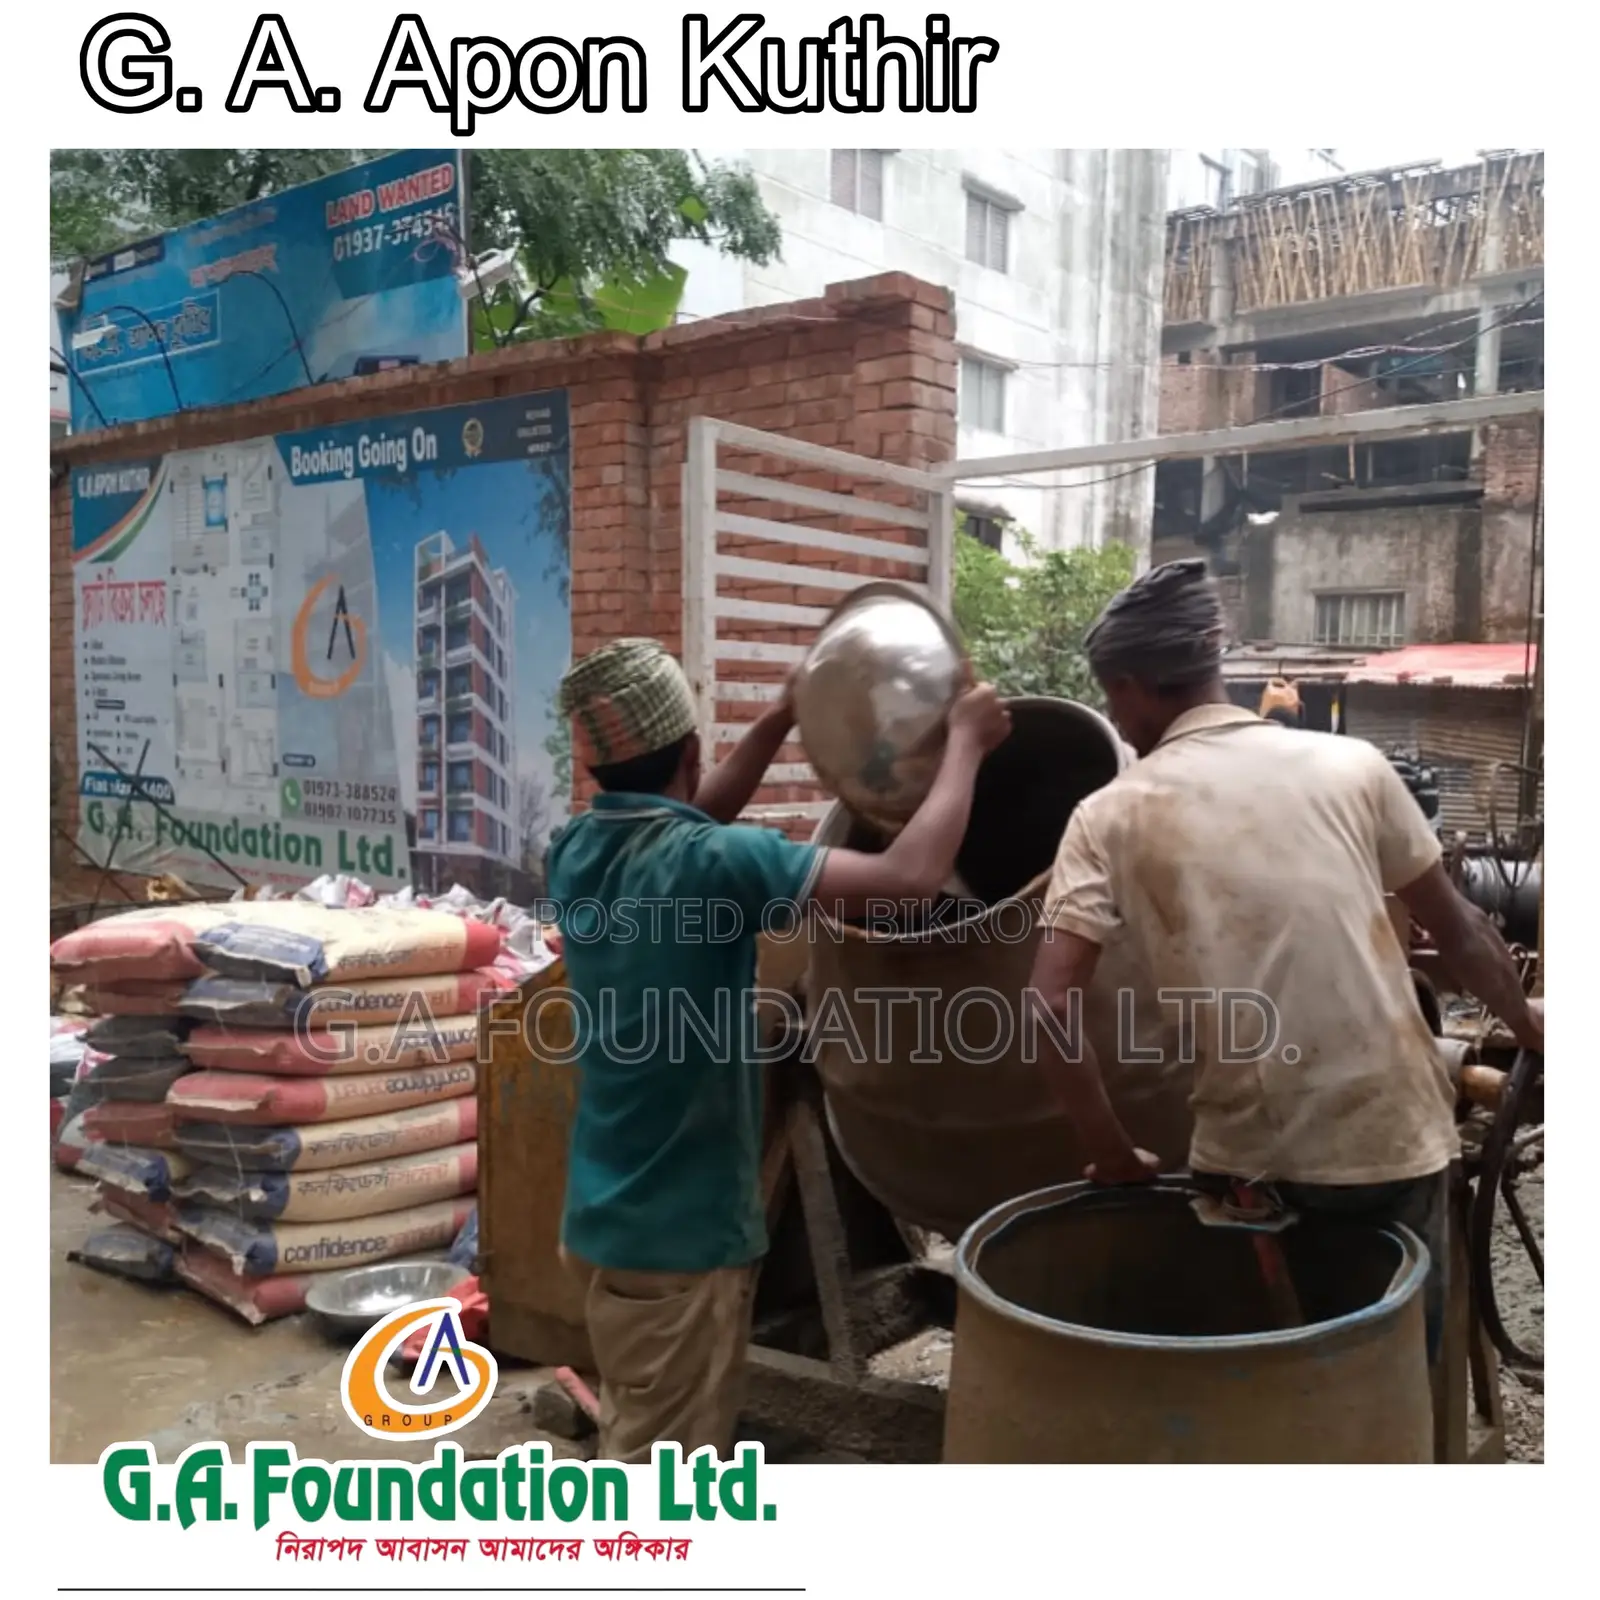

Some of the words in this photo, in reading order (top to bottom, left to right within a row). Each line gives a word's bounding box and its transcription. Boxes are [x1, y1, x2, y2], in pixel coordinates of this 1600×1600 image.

[326, 189, 376, 230] LAND
[376, 162, 455, 213] WANTED
[290, 440, 354, 479] Booking
[357, 432, 408, 473] Going
[410, 426, 439, 462] On
[155, 805, 323, 869] Foundation
[337, 829, 406, 879] Ltd.
[284, 1234, 389, 1264] confidence
